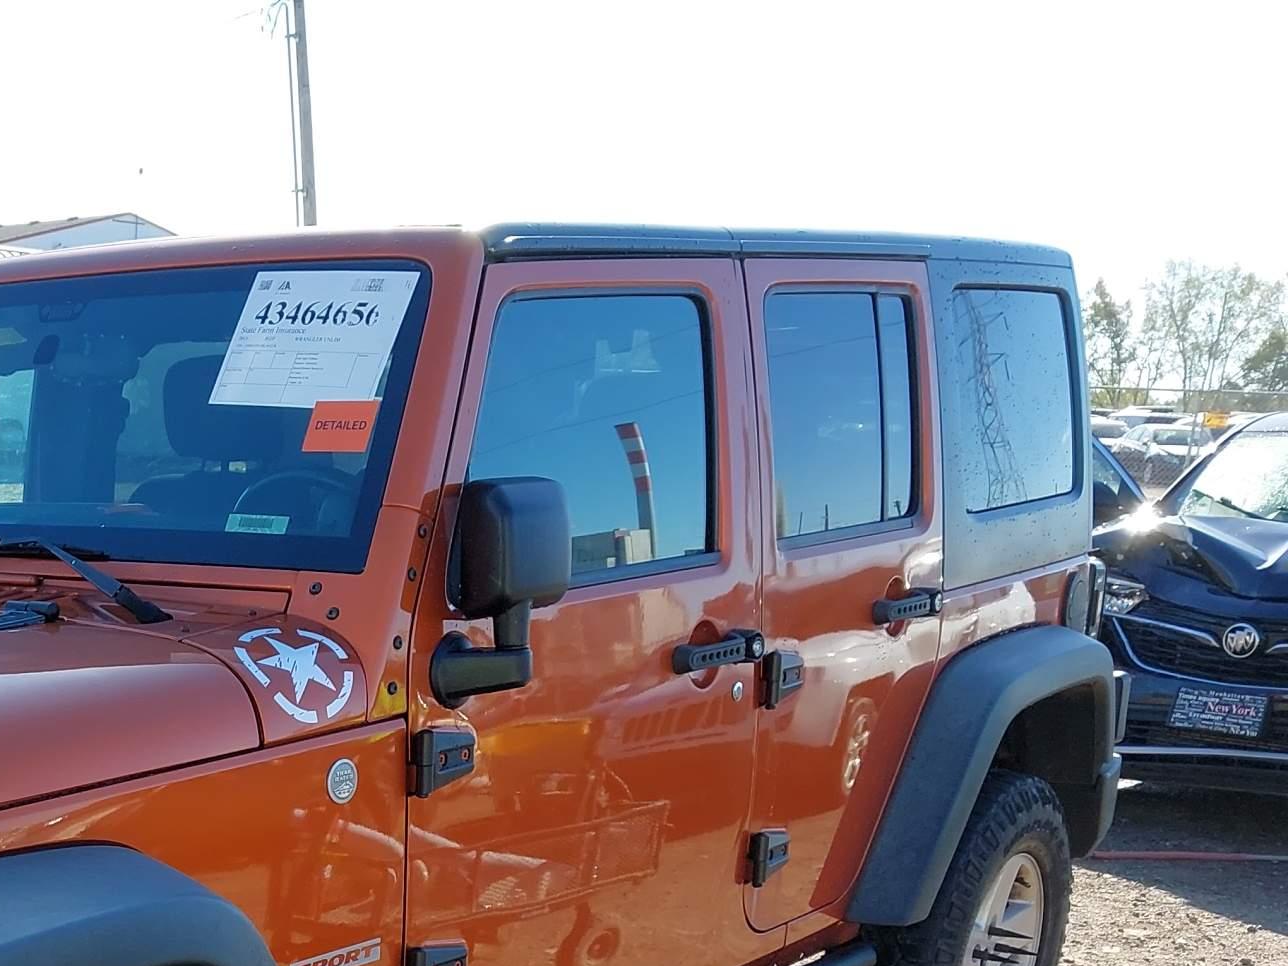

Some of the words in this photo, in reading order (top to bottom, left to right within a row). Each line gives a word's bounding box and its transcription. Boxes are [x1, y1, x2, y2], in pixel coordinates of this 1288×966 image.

[255, 301, 379, 327] 43464656
[315, 420, 368, 430] DETAILED
[1205, 702, 1229, 714] New
[1232, 704, 1257, 717] York
